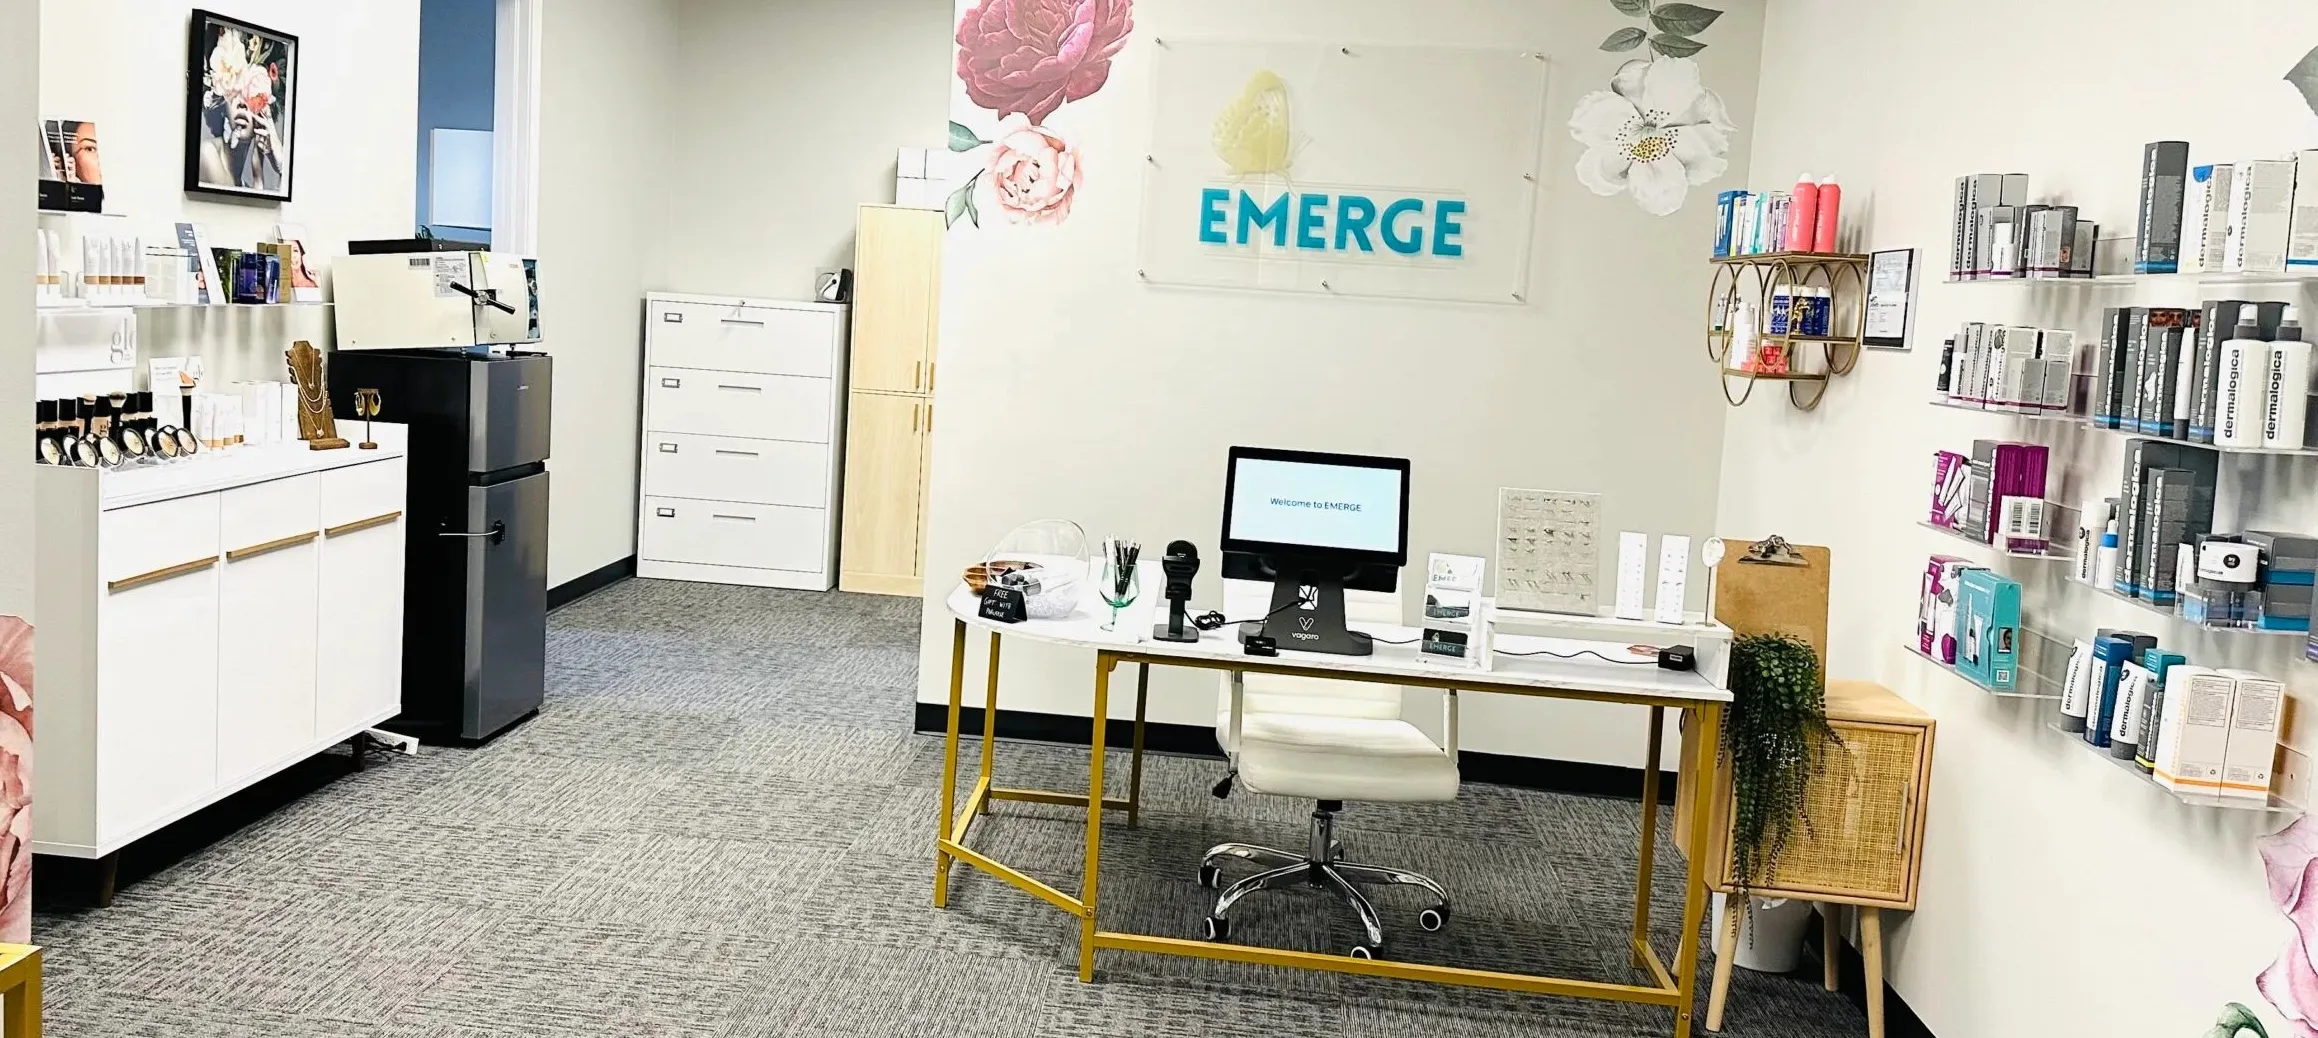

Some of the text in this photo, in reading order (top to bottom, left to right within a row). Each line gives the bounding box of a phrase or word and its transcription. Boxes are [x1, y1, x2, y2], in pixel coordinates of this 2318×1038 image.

[1199, 187, 1467, 257] EMERGE
[1955, 181, 1965, 270] dermalogica
[1967, 179, 1977, 270] dermalogica
[2142, 148, 2158, 262] dermalogica
[2237, 166, 2252, 268] dermalogica
[2133, 313, 2149, 419] dermalogica
[2155, 331, 2168, 423] dermalogica
[2198, 307, 2217, 427] dermalogica
[2224, 349, 2240, 438] dermalogica
[2266, 350, 2283, 440] dermalogica
[1270, 497, 1362, 512] Welcome to EMERGE
[2124, 449, 2141, 584] dermalogica
[2148, 476, 2163, 590] dermalogica
[993, 588, 1009, 599] FREE
[2081, 529, 2091, 579] dermalogica
[1291, 631, 1320, 641] vagaro
[1429, 642, 1457, 653] EMERGE
